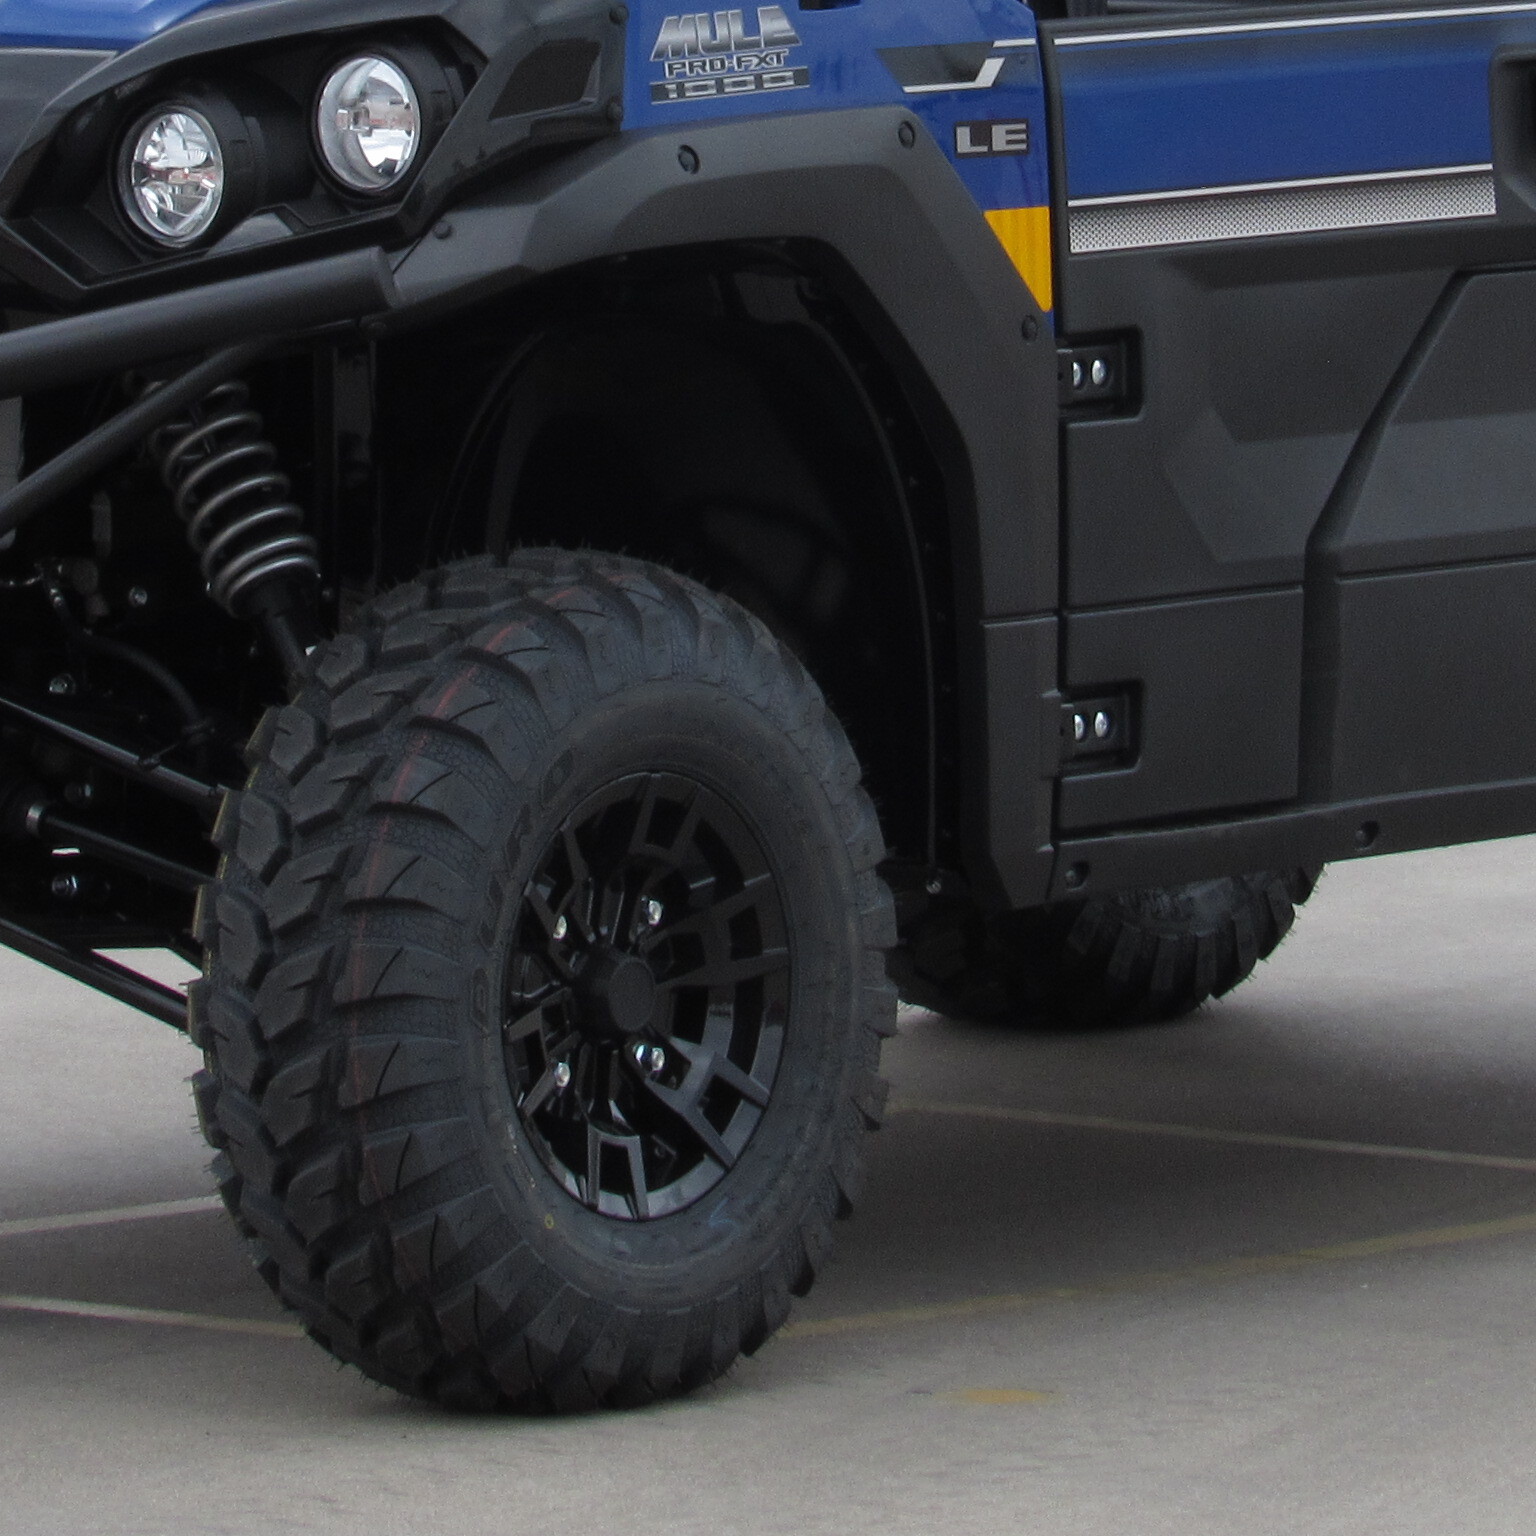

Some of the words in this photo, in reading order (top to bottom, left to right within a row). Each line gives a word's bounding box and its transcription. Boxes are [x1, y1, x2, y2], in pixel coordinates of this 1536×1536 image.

[650, 5, 802, 62] MULE
[666, 71, 796, 99] 1000
[955, 123, 1028, 154] LE
